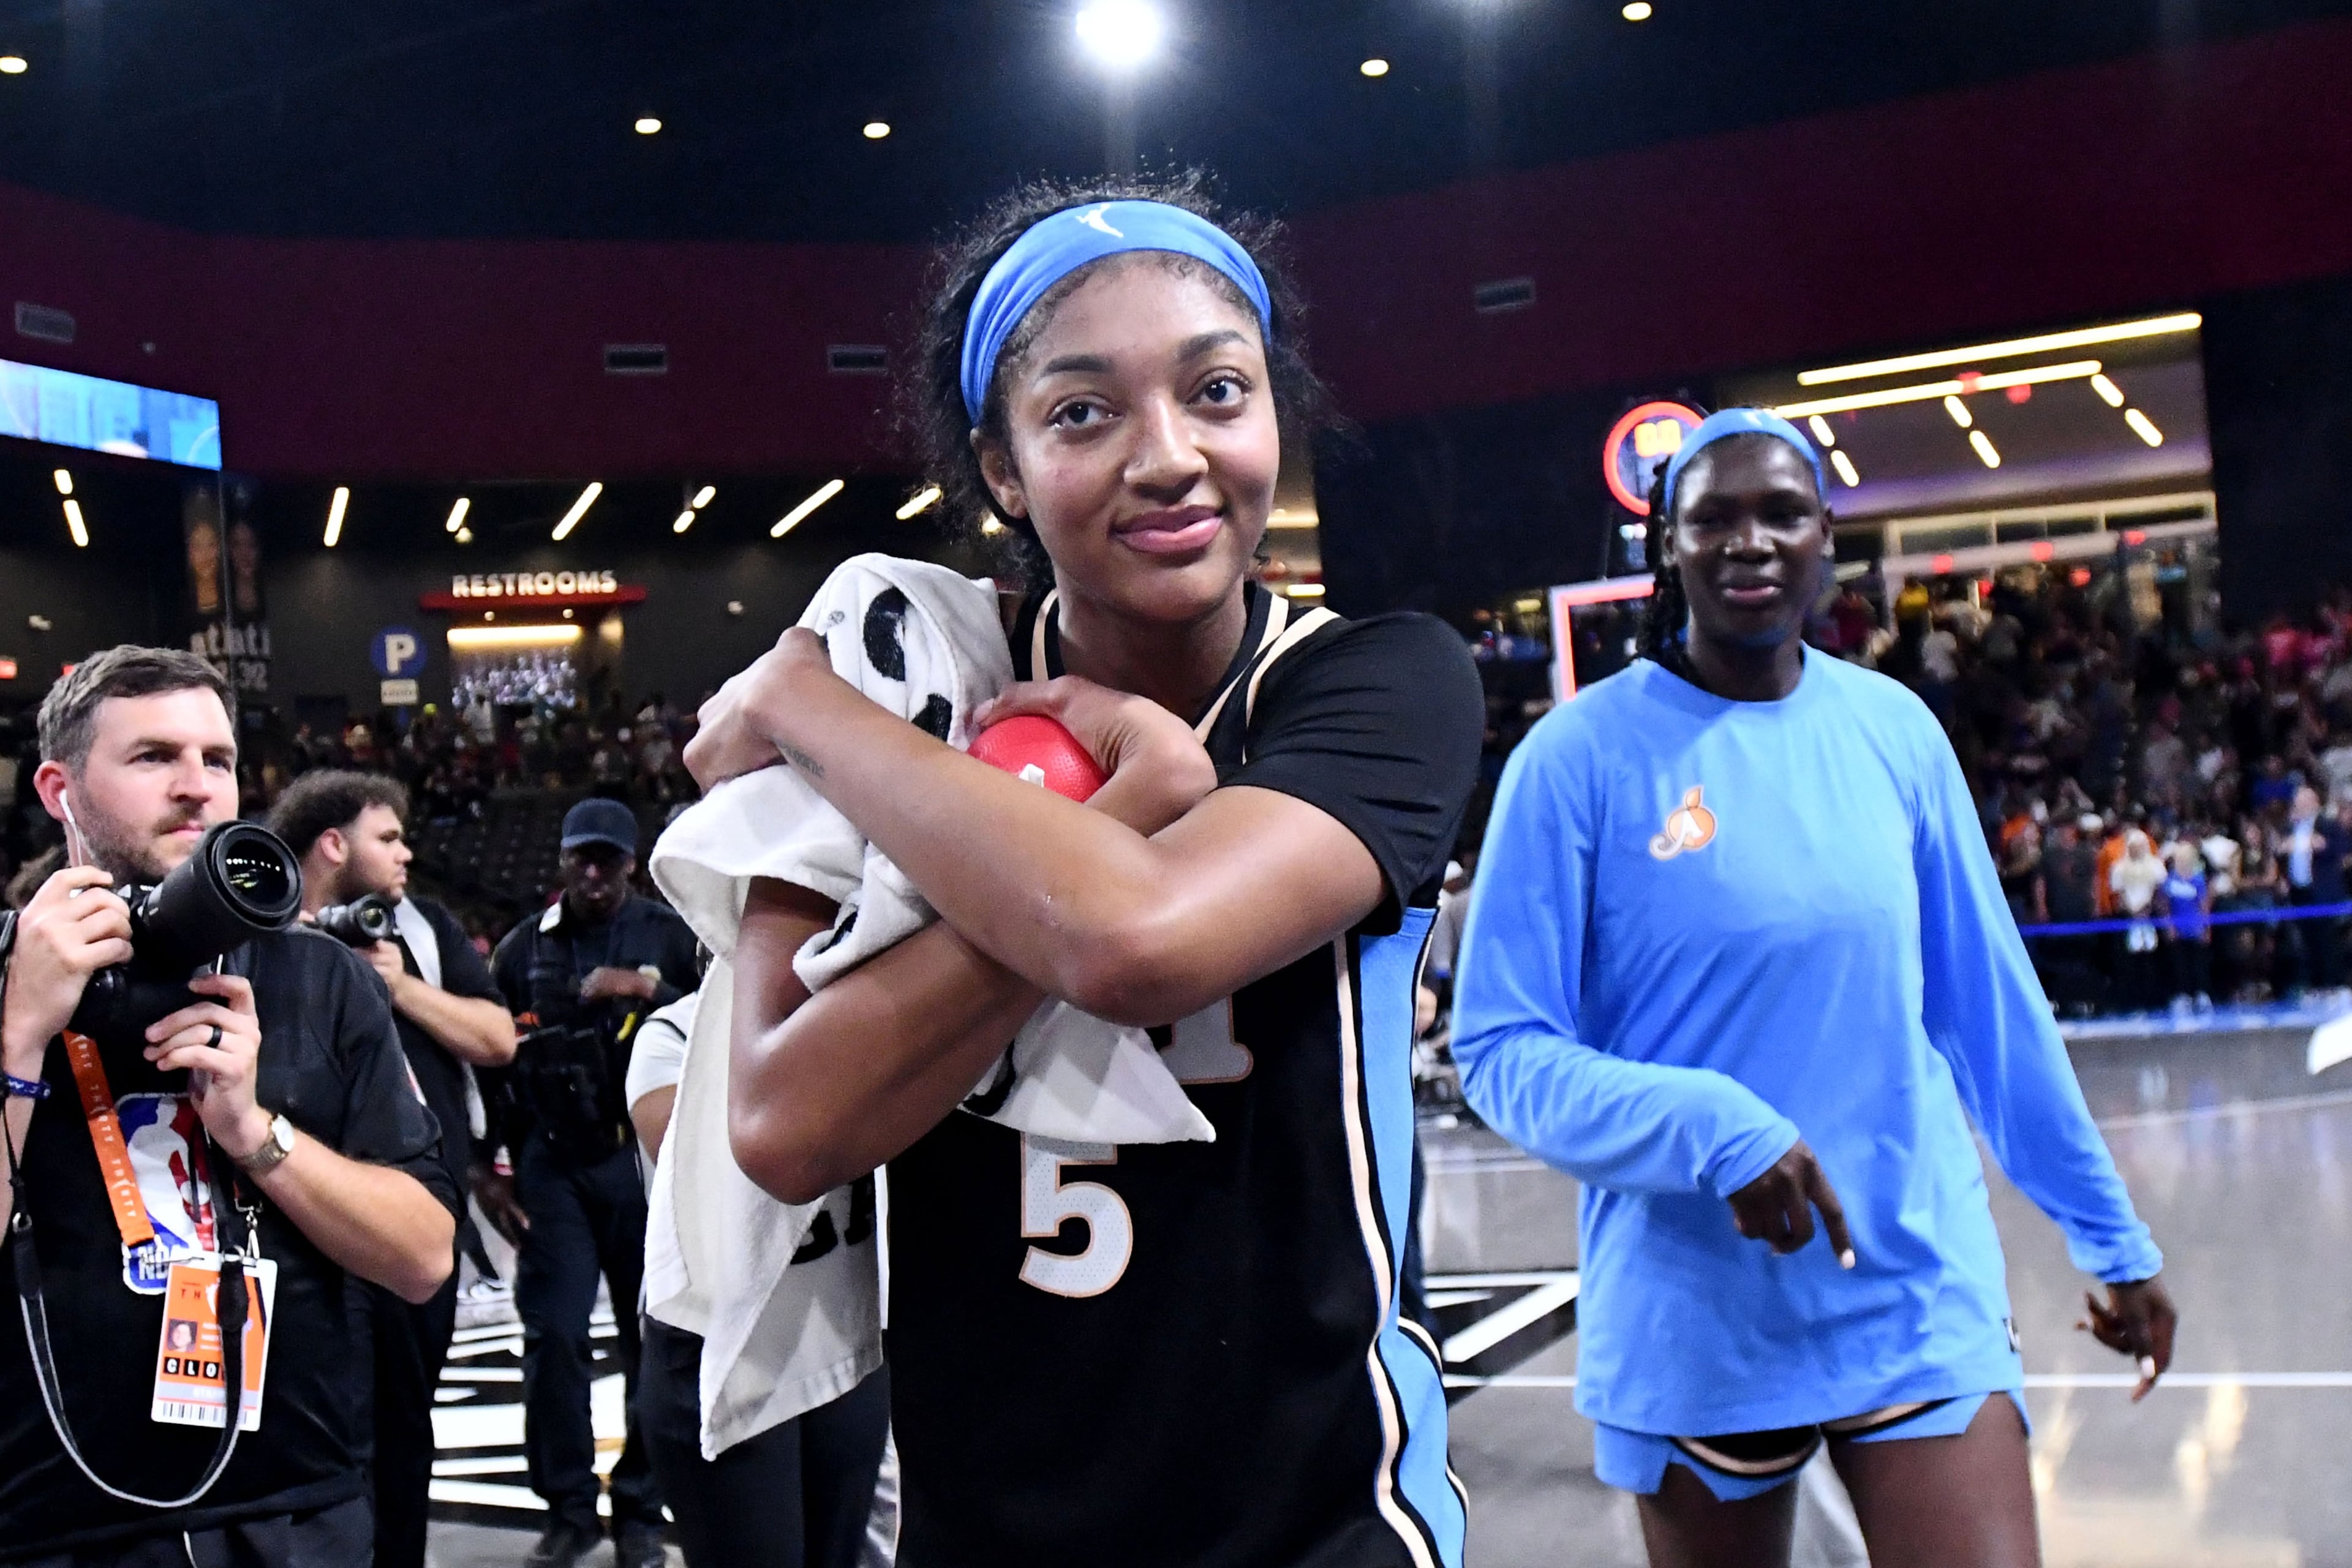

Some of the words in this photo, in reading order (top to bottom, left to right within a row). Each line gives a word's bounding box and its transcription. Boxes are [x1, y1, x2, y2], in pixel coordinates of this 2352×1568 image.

[451, 570, 618, 598] RESTROOMS
[385, 634, 417, 674] P
[1019, 1133, 1133, 1298] 5
[137, 1246, 172, 1280] NB
